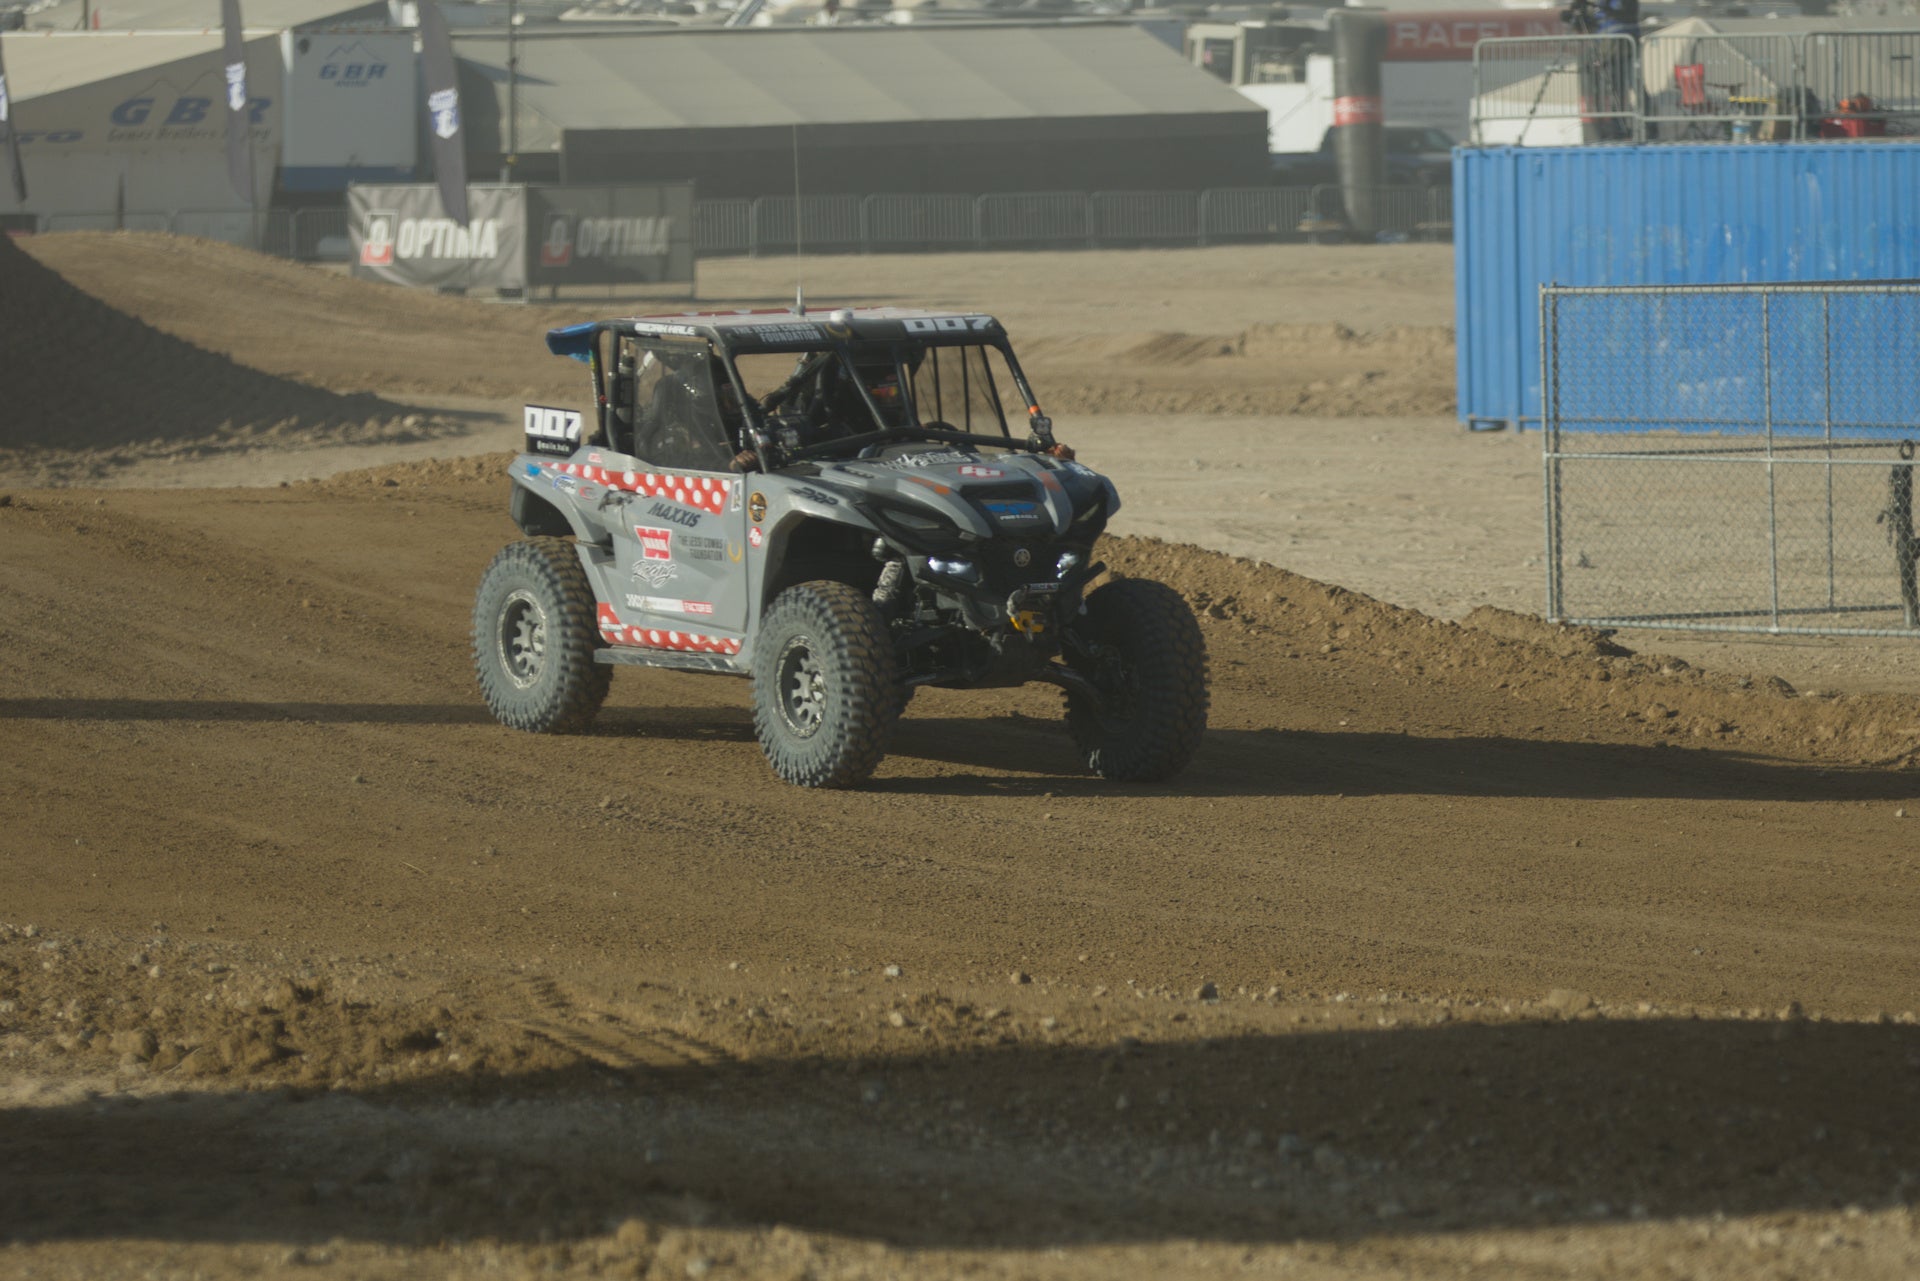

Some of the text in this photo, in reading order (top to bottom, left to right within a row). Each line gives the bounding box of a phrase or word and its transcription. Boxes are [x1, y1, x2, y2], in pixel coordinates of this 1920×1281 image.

[396, 217, 500, 259] OPTIMA
[576, 216, 670, 257] OPTIMA
[759, 330, 823, 343] FOUNDATION
[902, 316, 993, 333] 007
[524, 406, 582, 440] 007
[647, 502, 701, 528] MAXXIS
